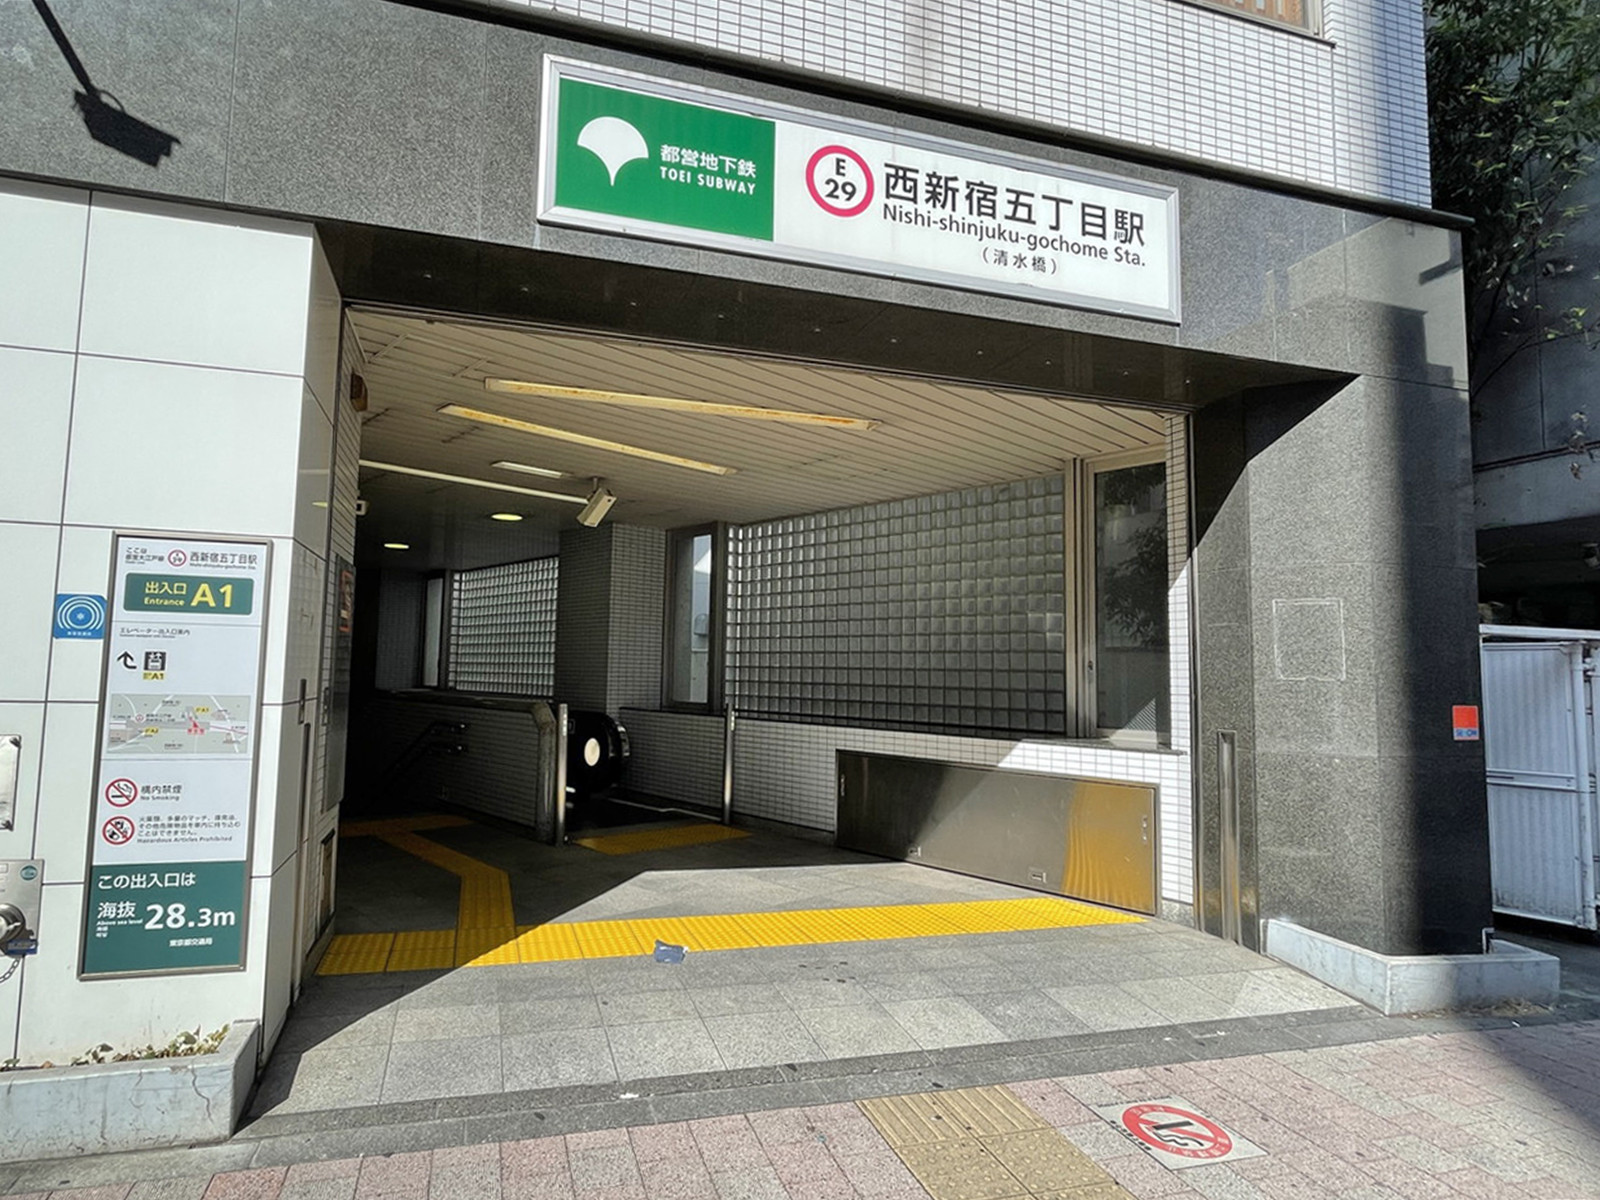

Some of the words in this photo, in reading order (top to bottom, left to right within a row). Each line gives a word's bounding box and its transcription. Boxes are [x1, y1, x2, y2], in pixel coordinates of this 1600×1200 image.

[660, 144, 757, 179] 都営地下鉄
[834, 157, 847, 177] E
[660, 166, 692, 184] TOEI
[697, 173, 756, 195] SUBWAY
[824, 178, 857, 202] 29
[883, 162, 1146, 247] 西新宿五丁目駅
[882, 202, 1109, 260] Nishi-shinjuku-gochome
[1114, 246, 1146, 267] Sta.
[190, 551, 258, 565] 西新宿五丁目駅
[145, 581, 187, 596] 出入口
[190, 583, 234, 609] A1
[144, 597, 185, 607] Entrance
[141, 785, 182, 795] 構内禁煙
[98, 871, 196, 890] この出入口は
[97, 901, 136, 919] 海抜
[144, 903, 236, 930] 28.3m
